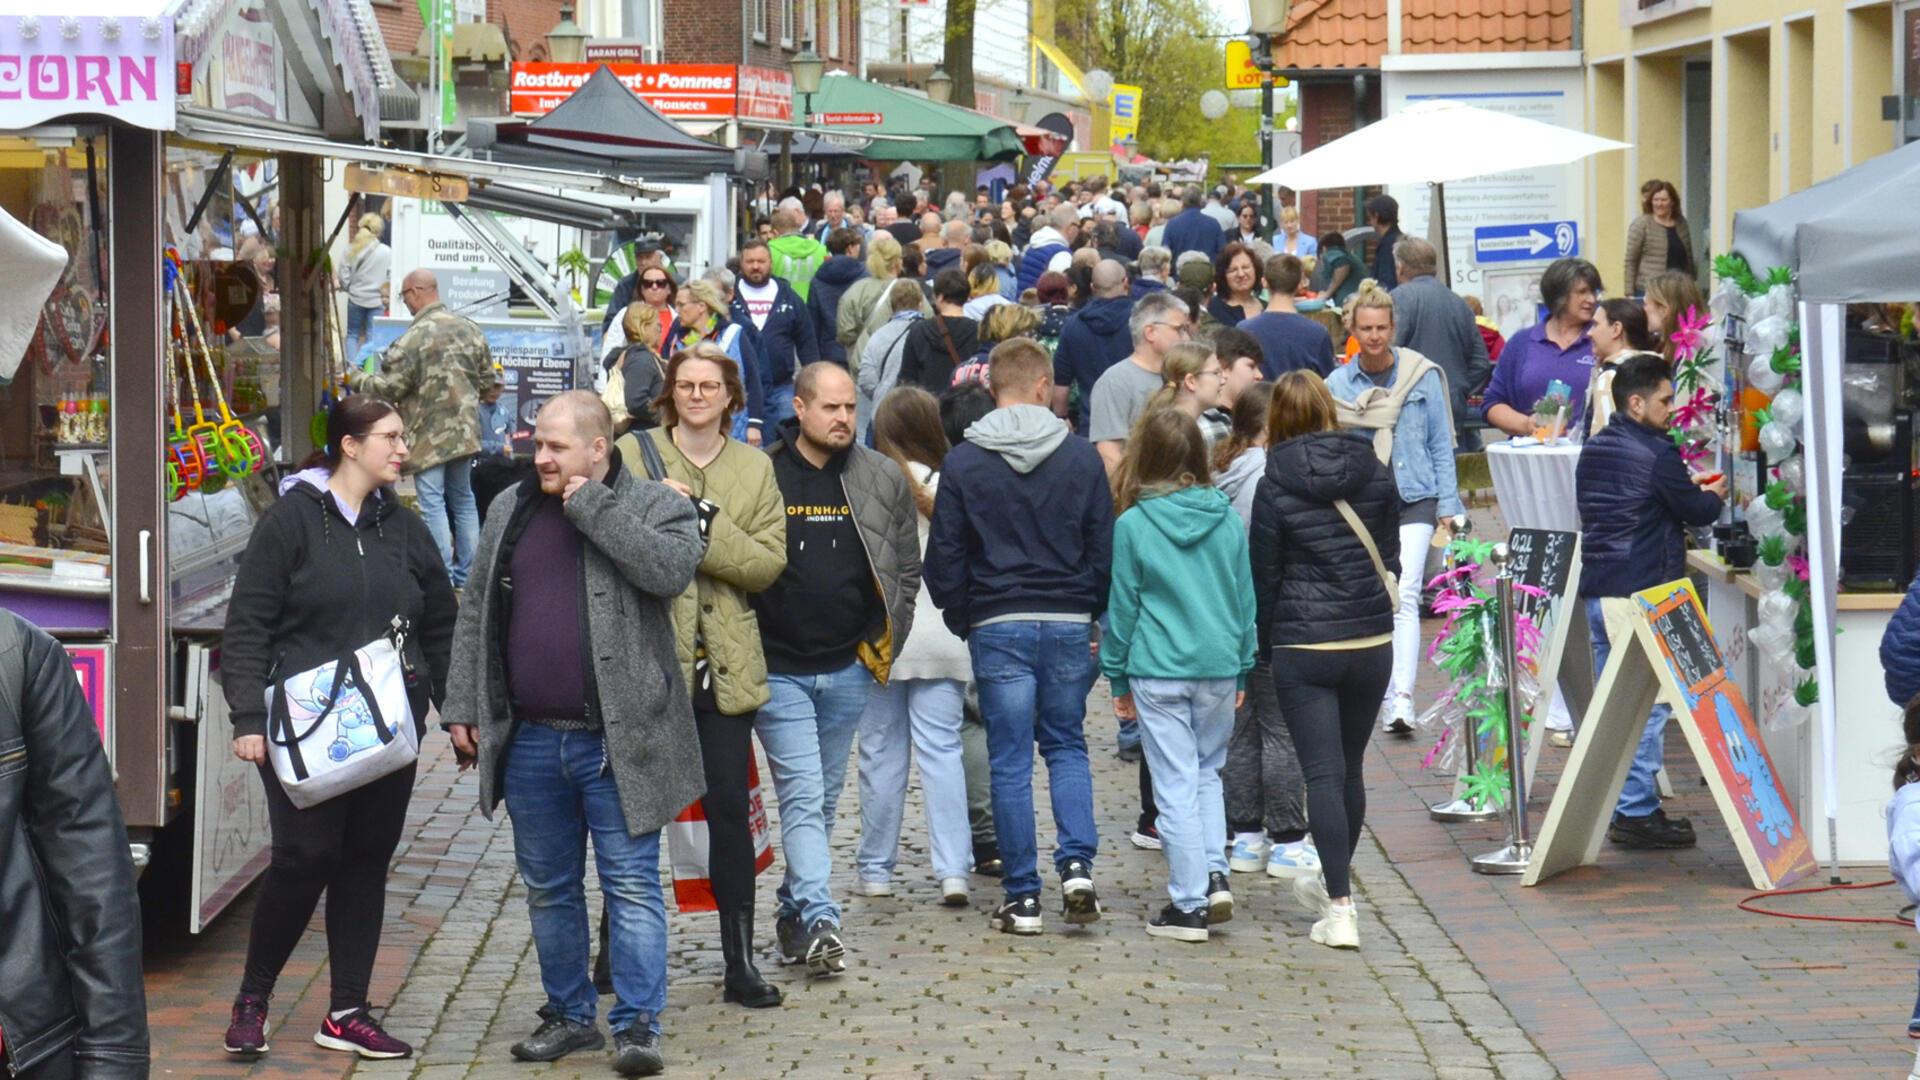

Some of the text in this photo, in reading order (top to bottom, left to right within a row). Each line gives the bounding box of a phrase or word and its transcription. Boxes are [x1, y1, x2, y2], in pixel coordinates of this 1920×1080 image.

[587, 48, 640, 57] BARAN GRILL
[656, 72, 732, 88] Pommes
[653, 99, 707, 111] Monsees
[1115, 94, 1133, 118] E
[434, 252, 460, 262] rund
[462, 254, 485, 262] ums
[452, 276, 495, 288] Beratung
[491, 345, 549, 356] nergiesparen
[502, 355, 541, 368] höchster
[542, 357, 571, 369] Ebene
